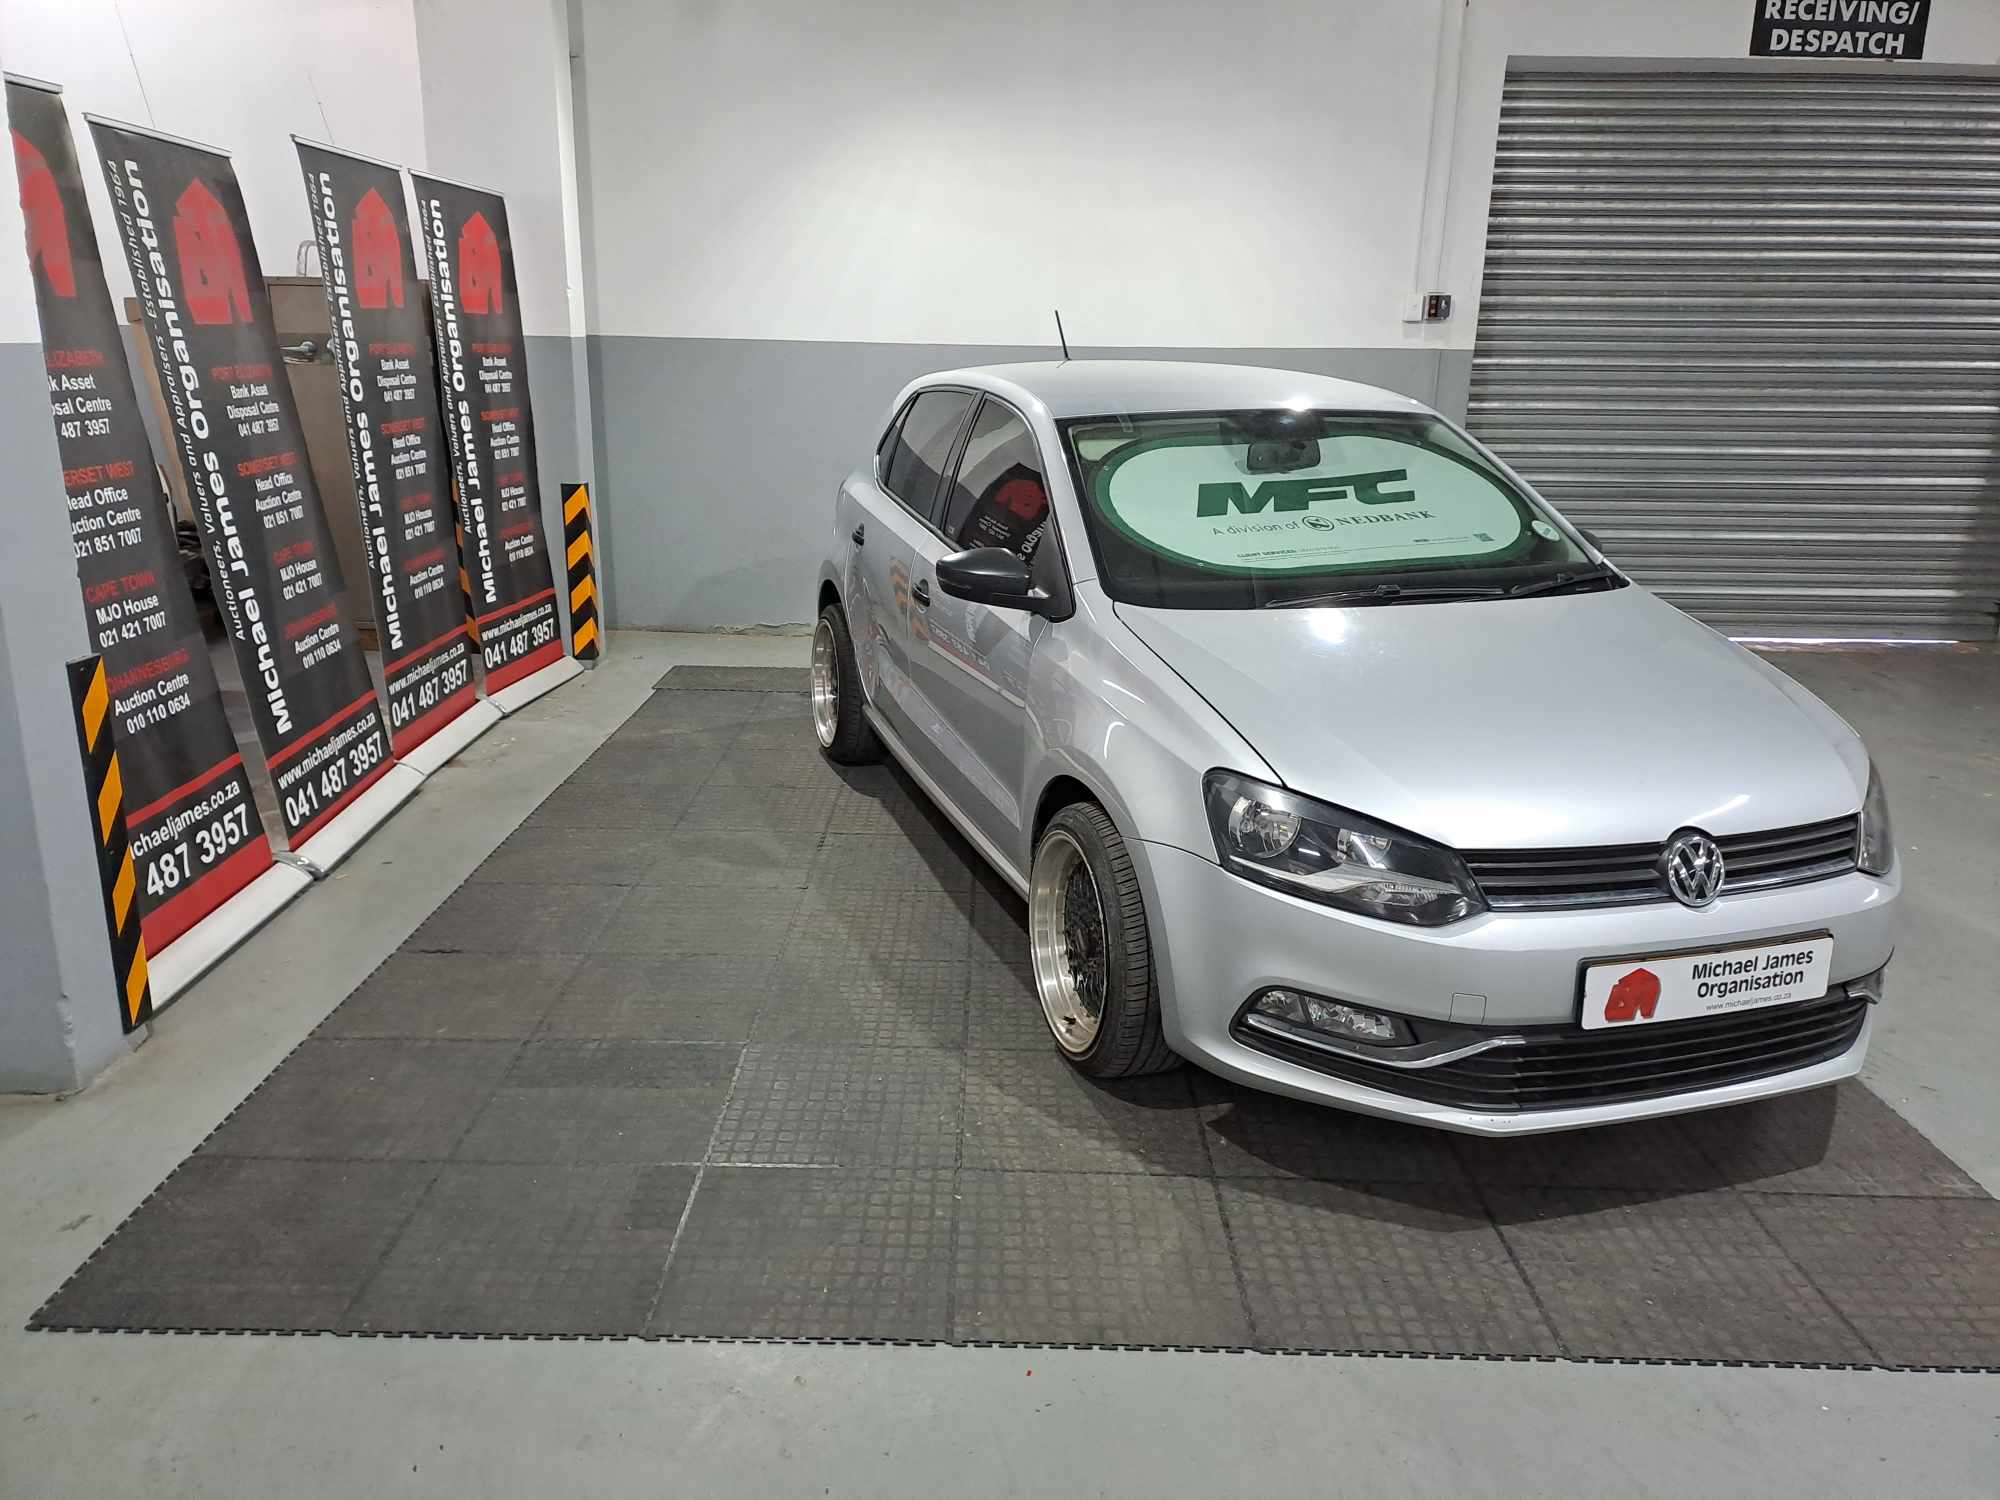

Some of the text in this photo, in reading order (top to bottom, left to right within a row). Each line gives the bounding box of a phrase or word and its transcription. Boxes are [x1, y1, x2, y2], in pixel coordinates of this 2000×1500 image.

[1765, 0, 1920, 25] RECEIVING/
[1770, 28, 1905, 55] DESPATCH
[120, 212, 157, 318] Established
[61, 374, 97, 391] Asset
[155, 335, 185, 430] Appraisers
[429, 199, 496, 603] Michael James Organisation
[76, 397, 112, 413] Centre
[319, 171, 403, 650] Michael James Organisation
[61, 418, 110, 438] 487 3957
[125, 160, 292, 735] Michael James Organisation
[181, 433, 197, 465] and
[94, 487, 128, 505] Office
[192, 470, 215, 533] Valuers
[1197, 469, 1415, 517] MFC
[107, 507, 142, 526] Centre
[1212, 519, 1301, 537] A division of
[1335, 510, 1437, 526] NEDBANK
[94, 534, 116, 553] 851
[117, 528, 142, 547] 7007
[213, 539, 246, 640] Auctioneers,
[96, 595, 160, 625] MJO House
[99, 611, 167, 648] 021 421 7007
[484, 618, 554, 669] 041 487 3957
[115, 674, 189, 716] Auction Centre
[391, 659, 467, 727] 041 487 3957
[126, 693, 191, 735] 010 110 0634
[278, 712, 376, 790] www.michaeljames.co.za
[285, 731, 383, 826] 041 487 3957
[147, 803, 249, 896] 487 3957
[1691, 950, 1814, 980] Michael James
[1697, 970, 1804, 999] Organisation
